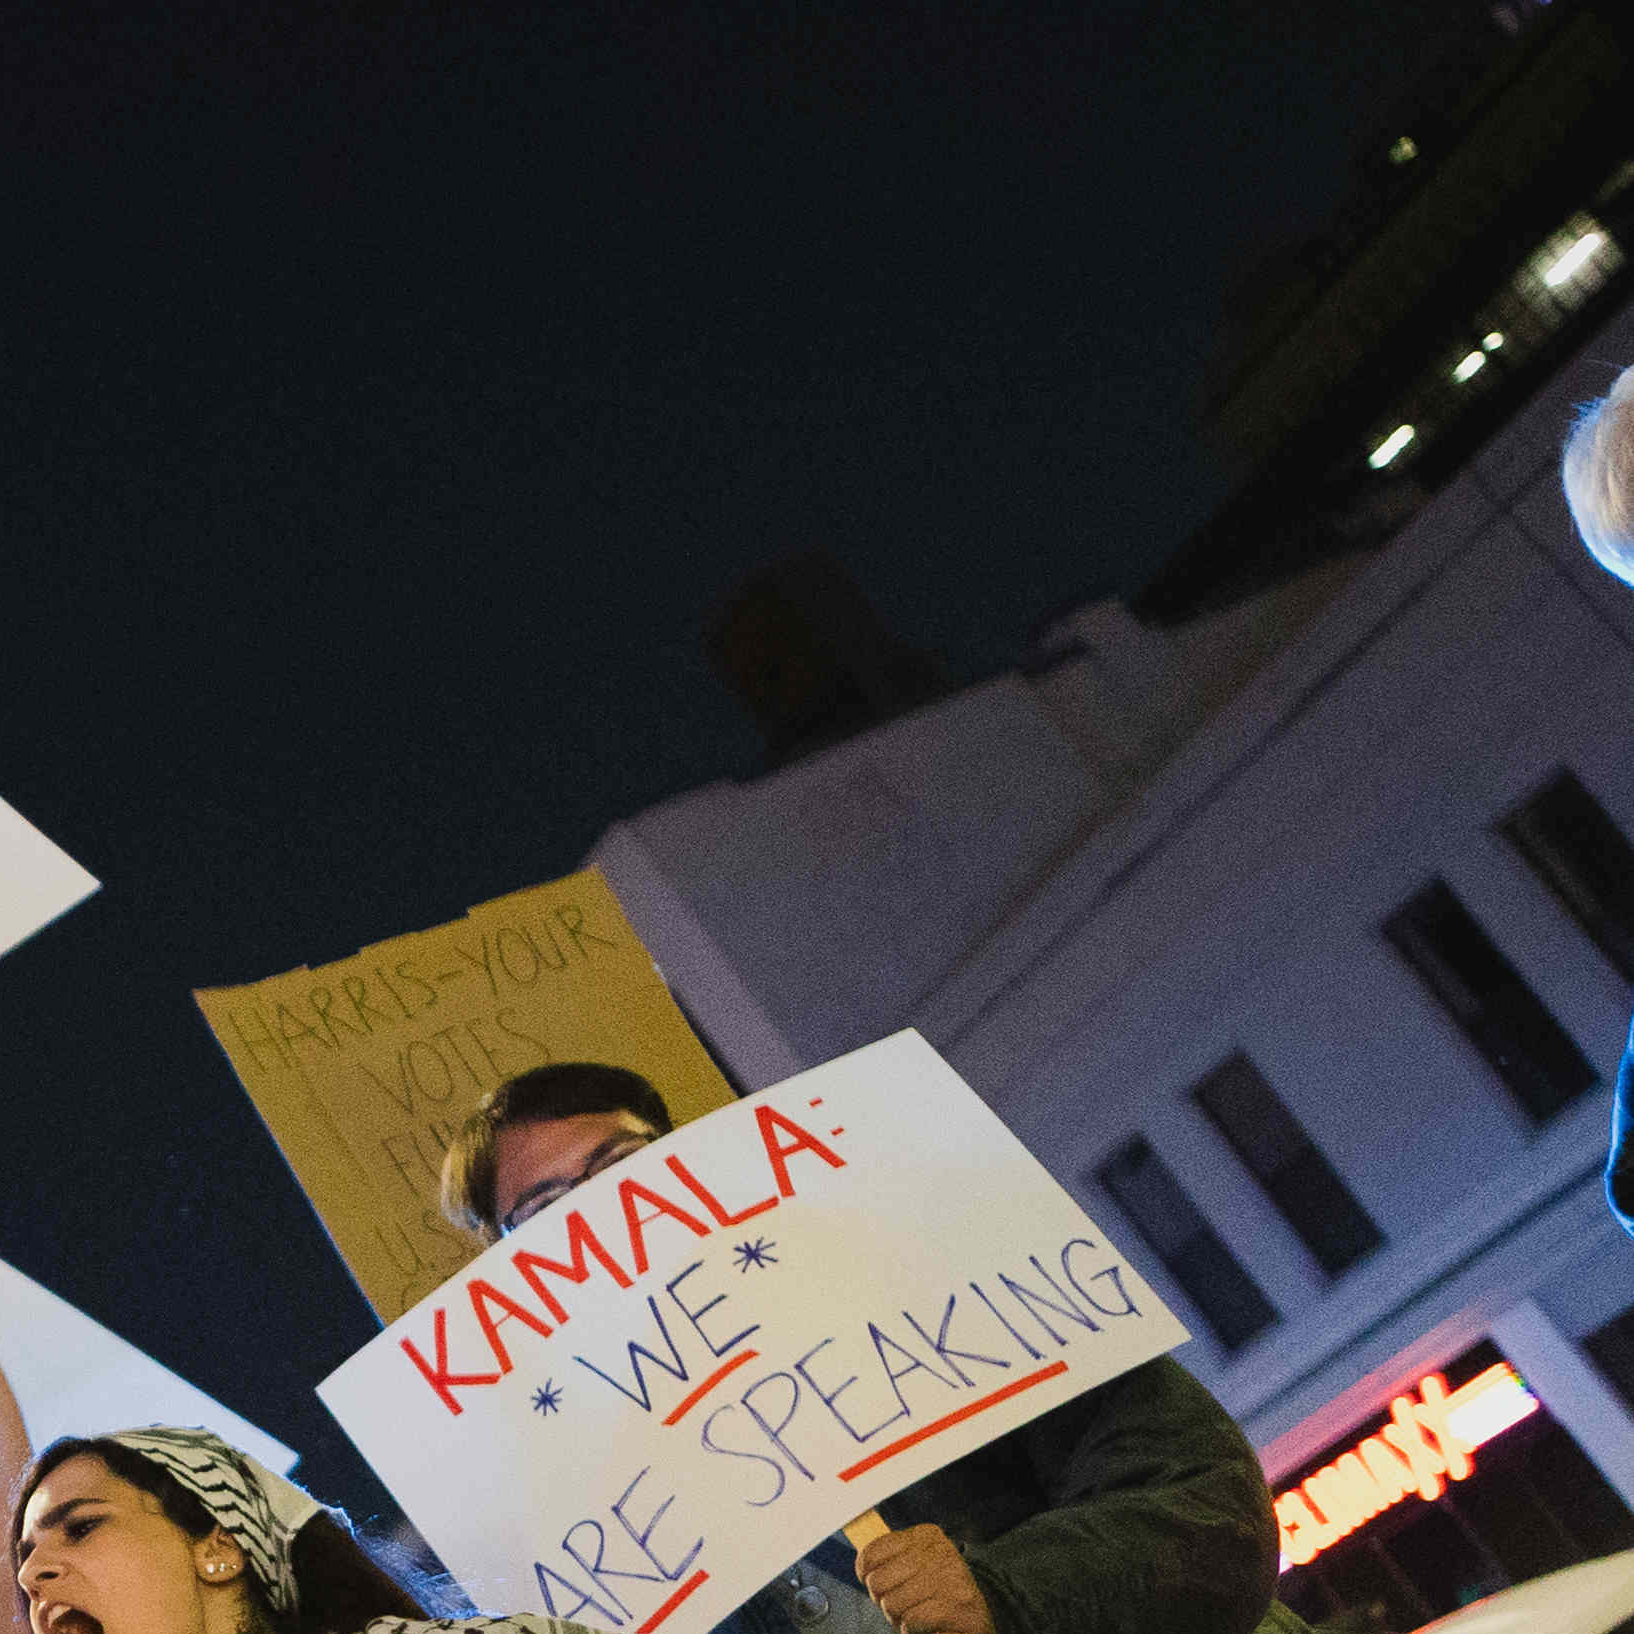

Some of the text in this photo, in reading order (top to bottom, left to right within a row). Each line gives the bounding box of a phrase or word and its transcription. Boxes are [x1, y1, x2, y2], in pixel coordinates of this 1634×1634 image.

[356, 1006, 552, 1119] VOTES
[399, 1095, 848, 1417] KAMALA:
[532, 1238, 1144, 1627] ARE SPEAKING
